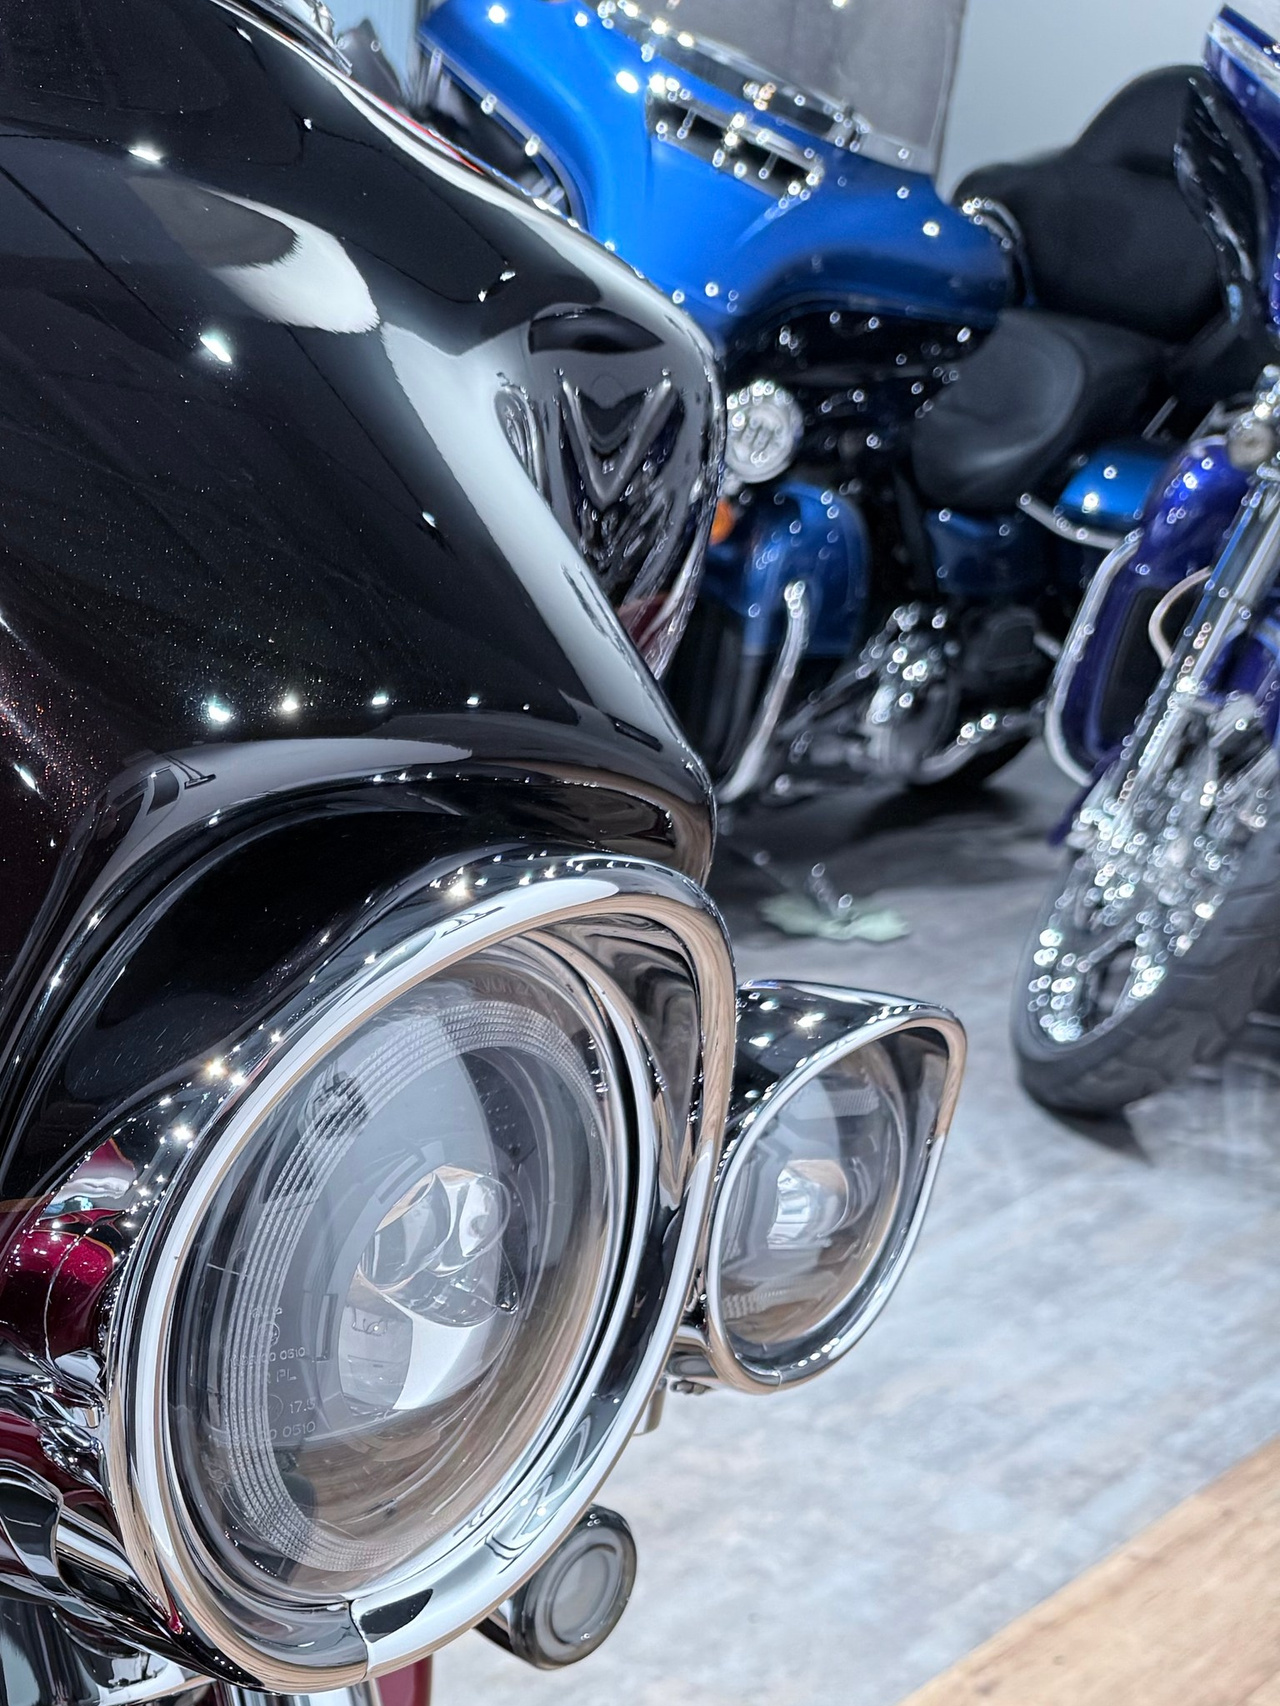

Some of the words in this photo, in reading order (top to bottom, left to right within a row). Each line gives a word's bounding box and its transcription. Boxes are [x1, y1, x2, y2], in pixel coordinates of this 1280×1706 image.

[279, 1346, 306, 1360] 0510
[276, 1368, 297, 1383] PL
[289, 1397, 316, 1414] 17.5
[282, 1421, 316, 1438] 0510
